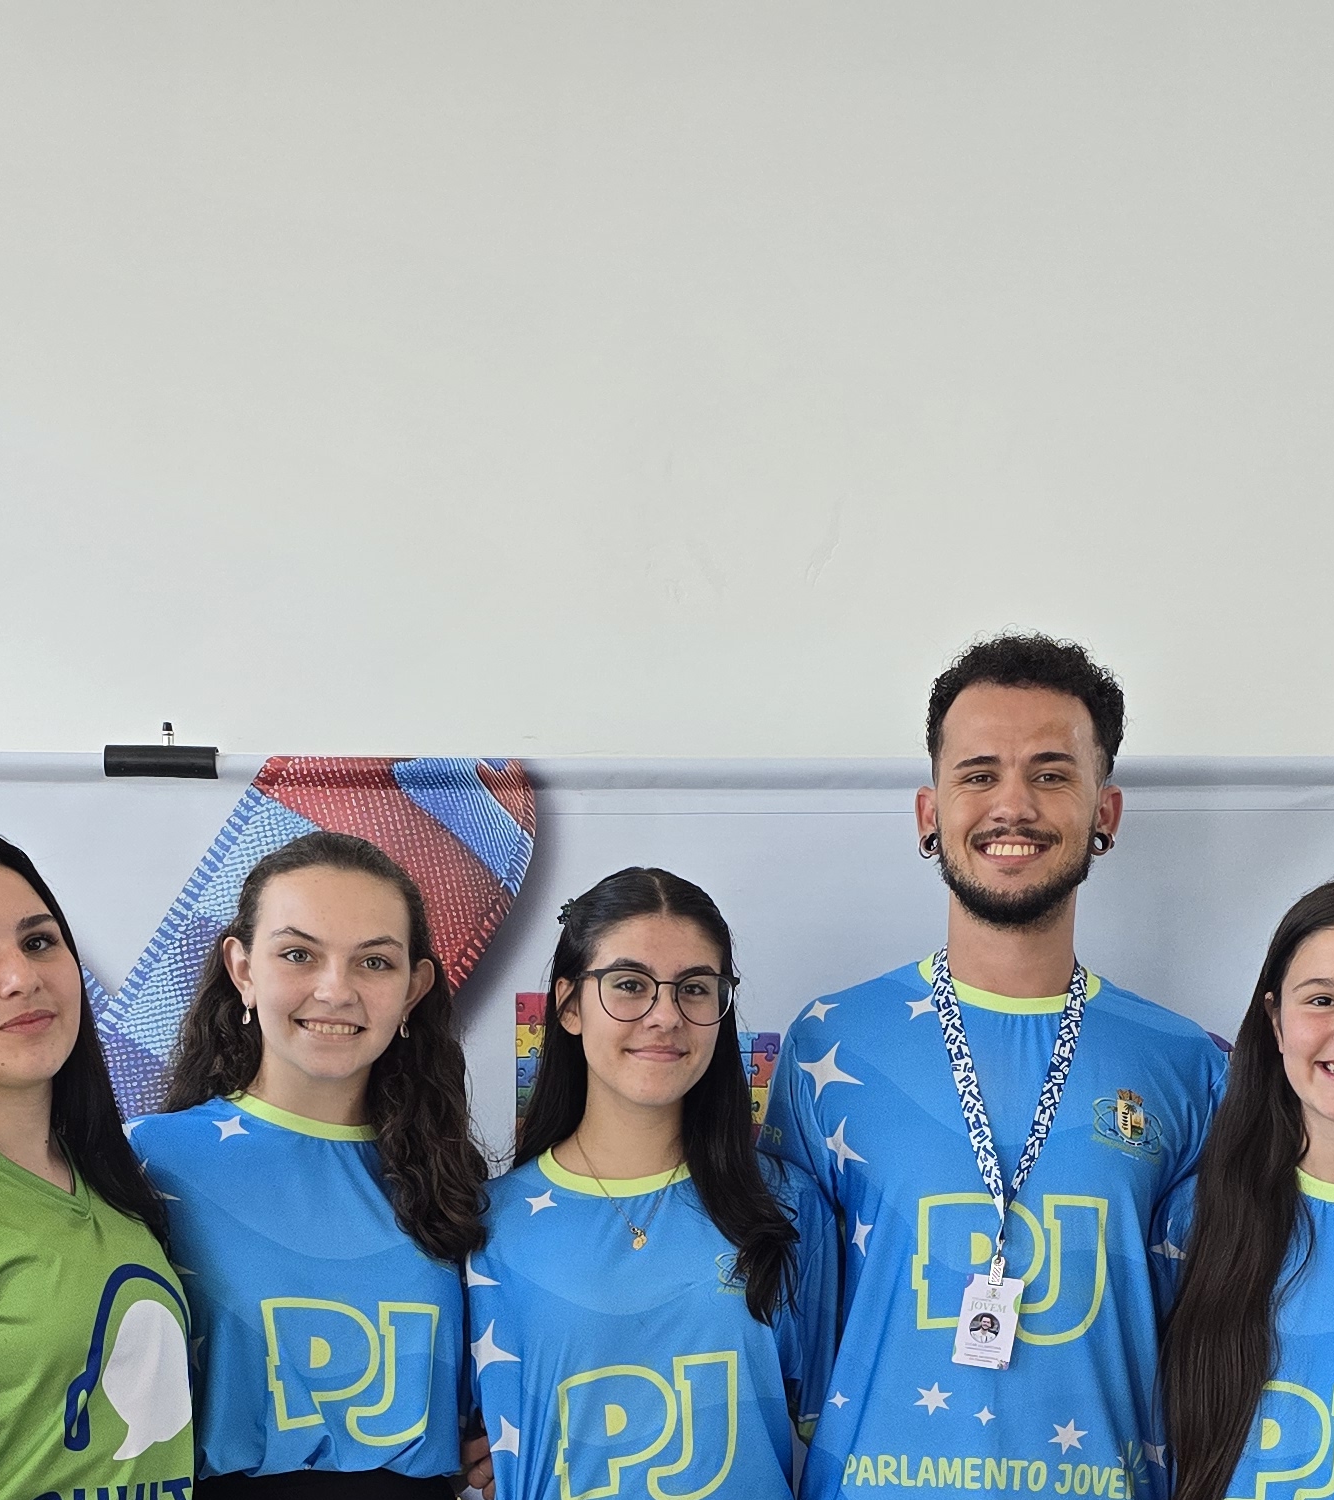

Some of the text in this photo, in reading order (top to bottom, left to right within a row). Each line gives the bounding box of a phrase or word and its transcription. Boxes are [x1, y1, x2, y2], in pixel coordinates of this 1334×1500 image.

[912, 1193, 1108, 1345] PJ
[261, 1297, 439, 1446] PJ
[843, 1453, 1047, 1492] PARLAMENTO
